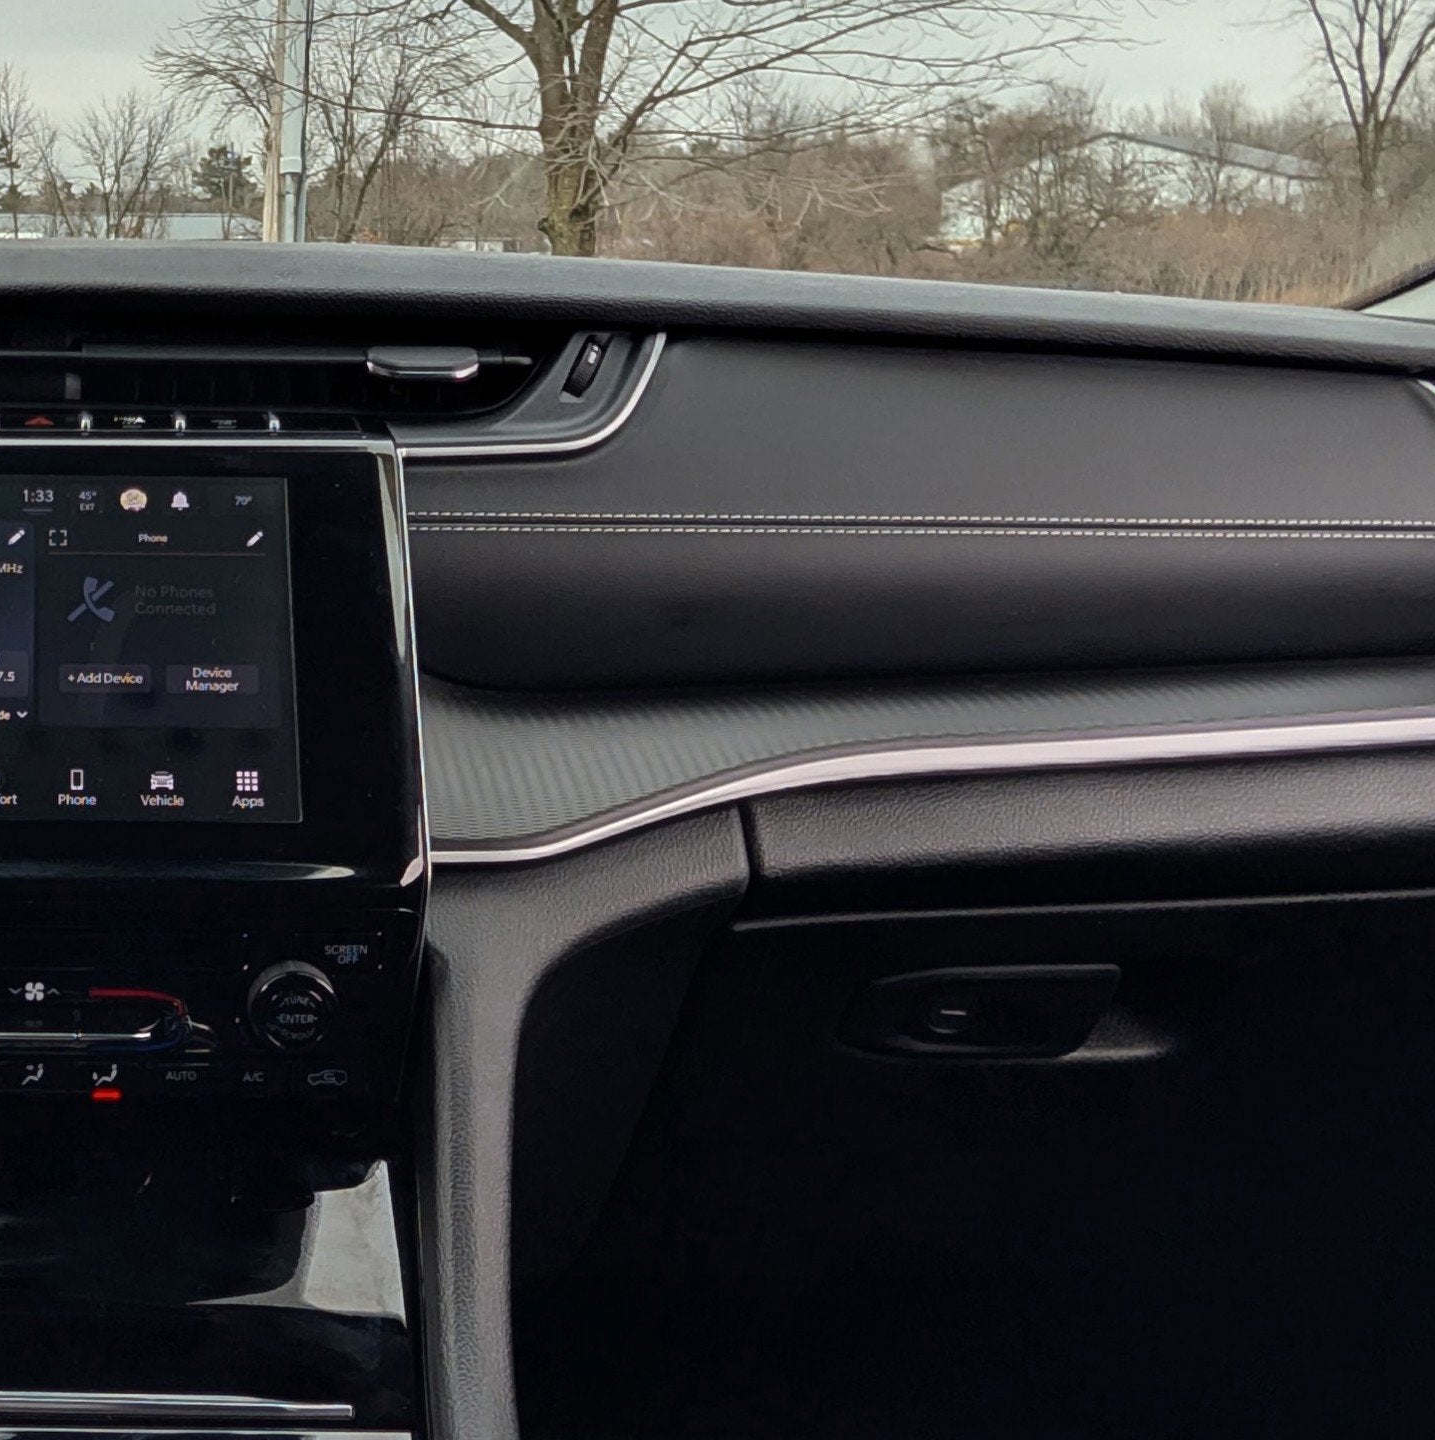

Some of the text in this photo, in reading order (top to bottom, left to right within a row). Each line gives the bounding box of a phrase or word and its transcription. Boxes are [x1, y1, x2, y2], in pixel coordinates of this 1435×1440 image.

[23, 490, 54, 503] 1:33
[138, 533, 169, 543] Phone
[135, 586, 215, 599] No Phones
[134, 601, 216, 615] Connected
[76, 673, 102, 684] Add
[103, 673, 144, 684] Device
[192, 667, 232, 679] Device
[185, 680, 240, 693] Manager
[58, 794, 97, 806] Phone
[140, 795, 185, 807] Vehicle
[232, 795, 265, 809] Apps
[324, 945, 368, 955] SCREEN
[337, 955, 359, 965] OFF
[278, 1013, 315, 1023] ENTER
[165, 1071, 197, 1081] AUTO
[242, 1071, 265, 1083] A/C
